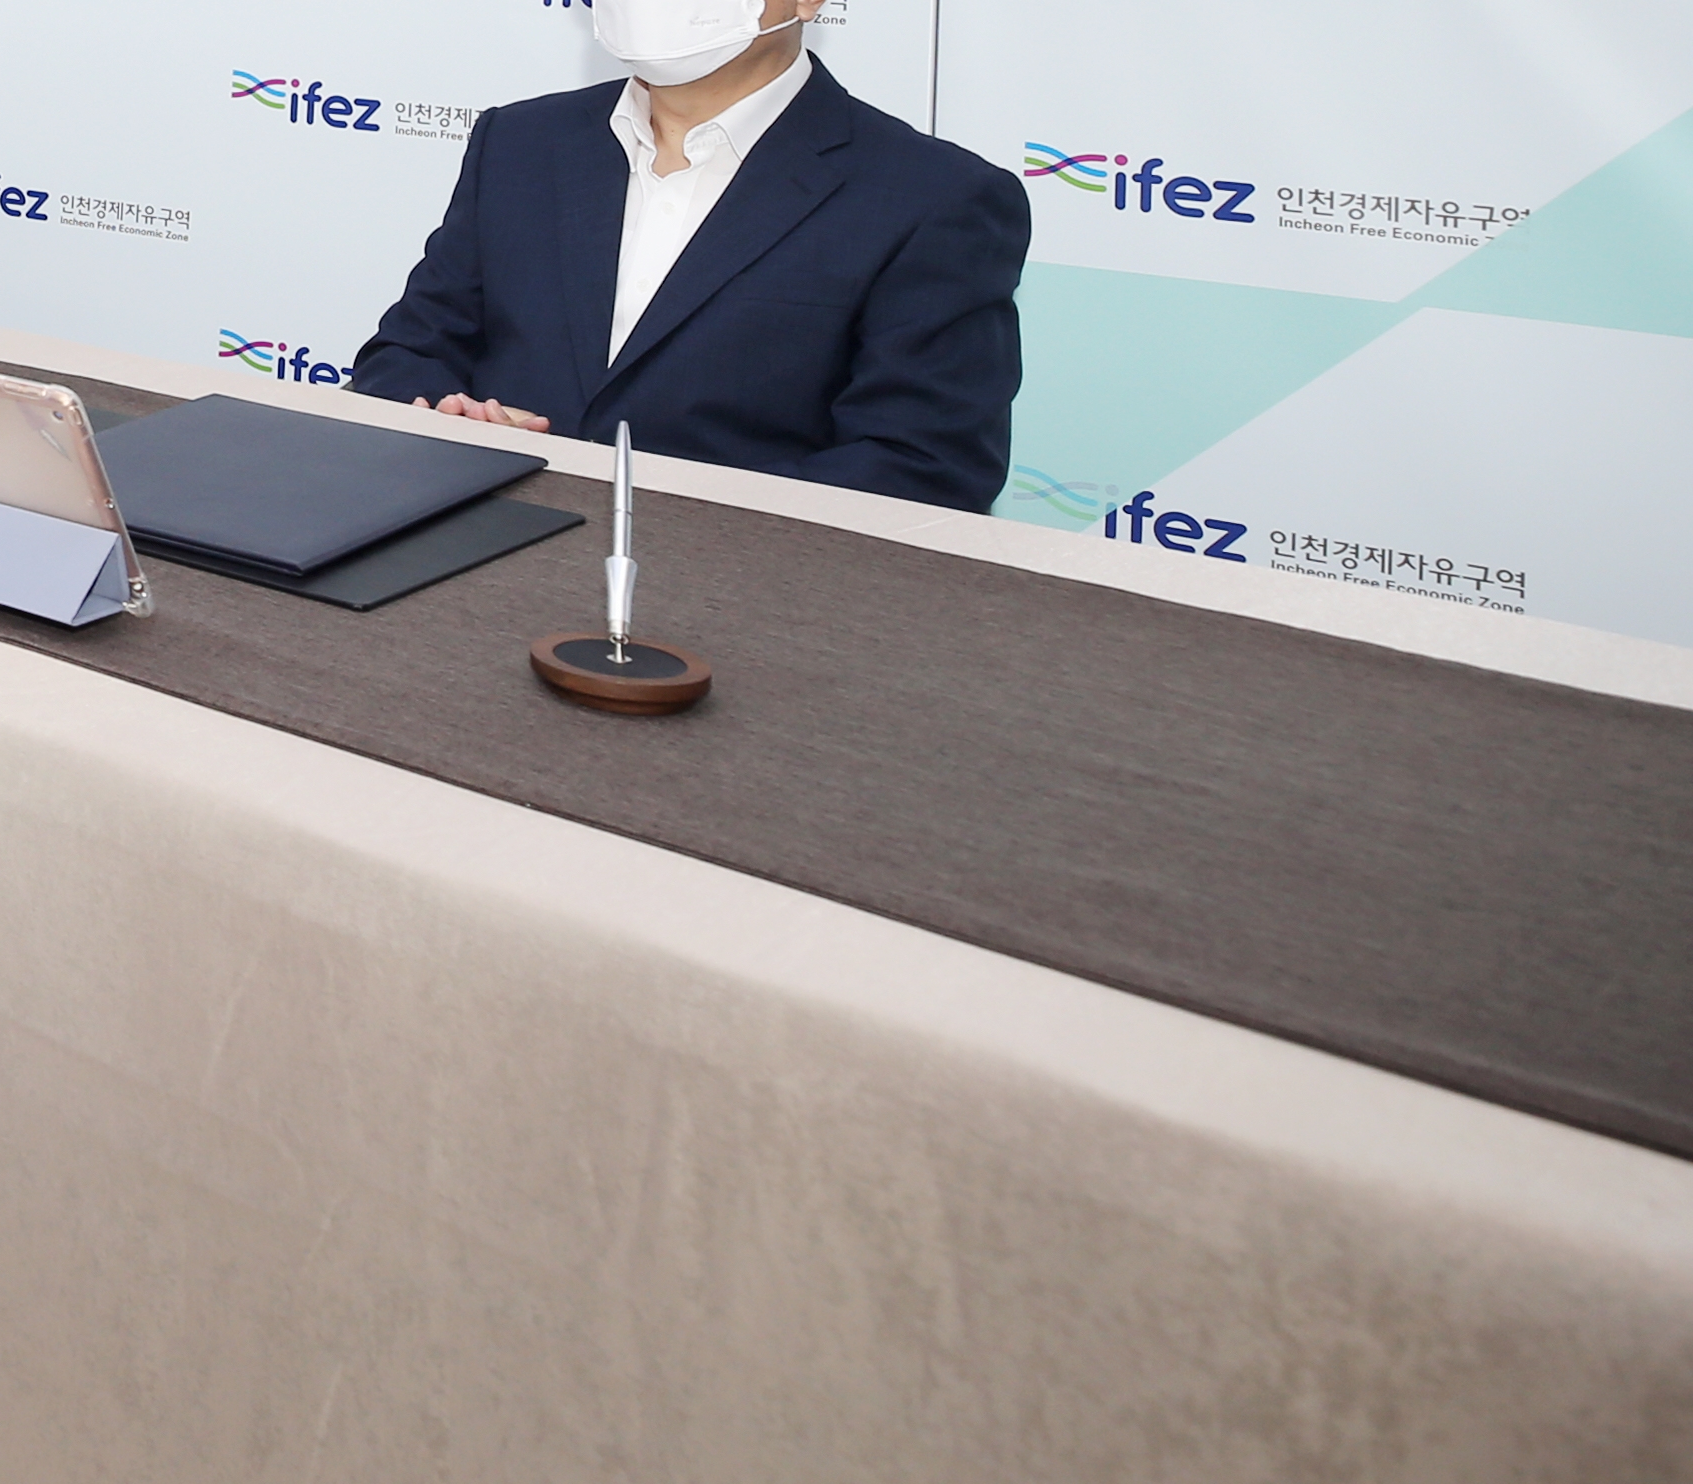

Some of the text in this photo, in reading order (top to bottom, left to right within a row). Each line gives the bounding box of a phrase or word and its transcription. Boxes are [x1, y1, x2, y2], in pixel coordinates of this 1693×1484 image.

[814, 14, 847, 25] Zone
[289, 78, 382, 132] ifez
[395, 126, 438, 138] Incheon
[440, 129, 464, 141] Free
[1114, 154, 1255, 224] ifez
[1276, 185, 1532, 231] 인천경제자유구역
[60, 194, 191, 230] 인천경제자유구역
[60, 215, 189, 243] Incheon Free Economic Zone
[1278, 215, 1346, 234] Incheon
[1349, 222, 1387, 238] Free
[1392, 226, 1480, 248] Economic
[277, 342, 354, 385] ife
[1103, 484, 1248, 564] ifez
[1269, 529, 1528, 600] 인천경제자유구역
